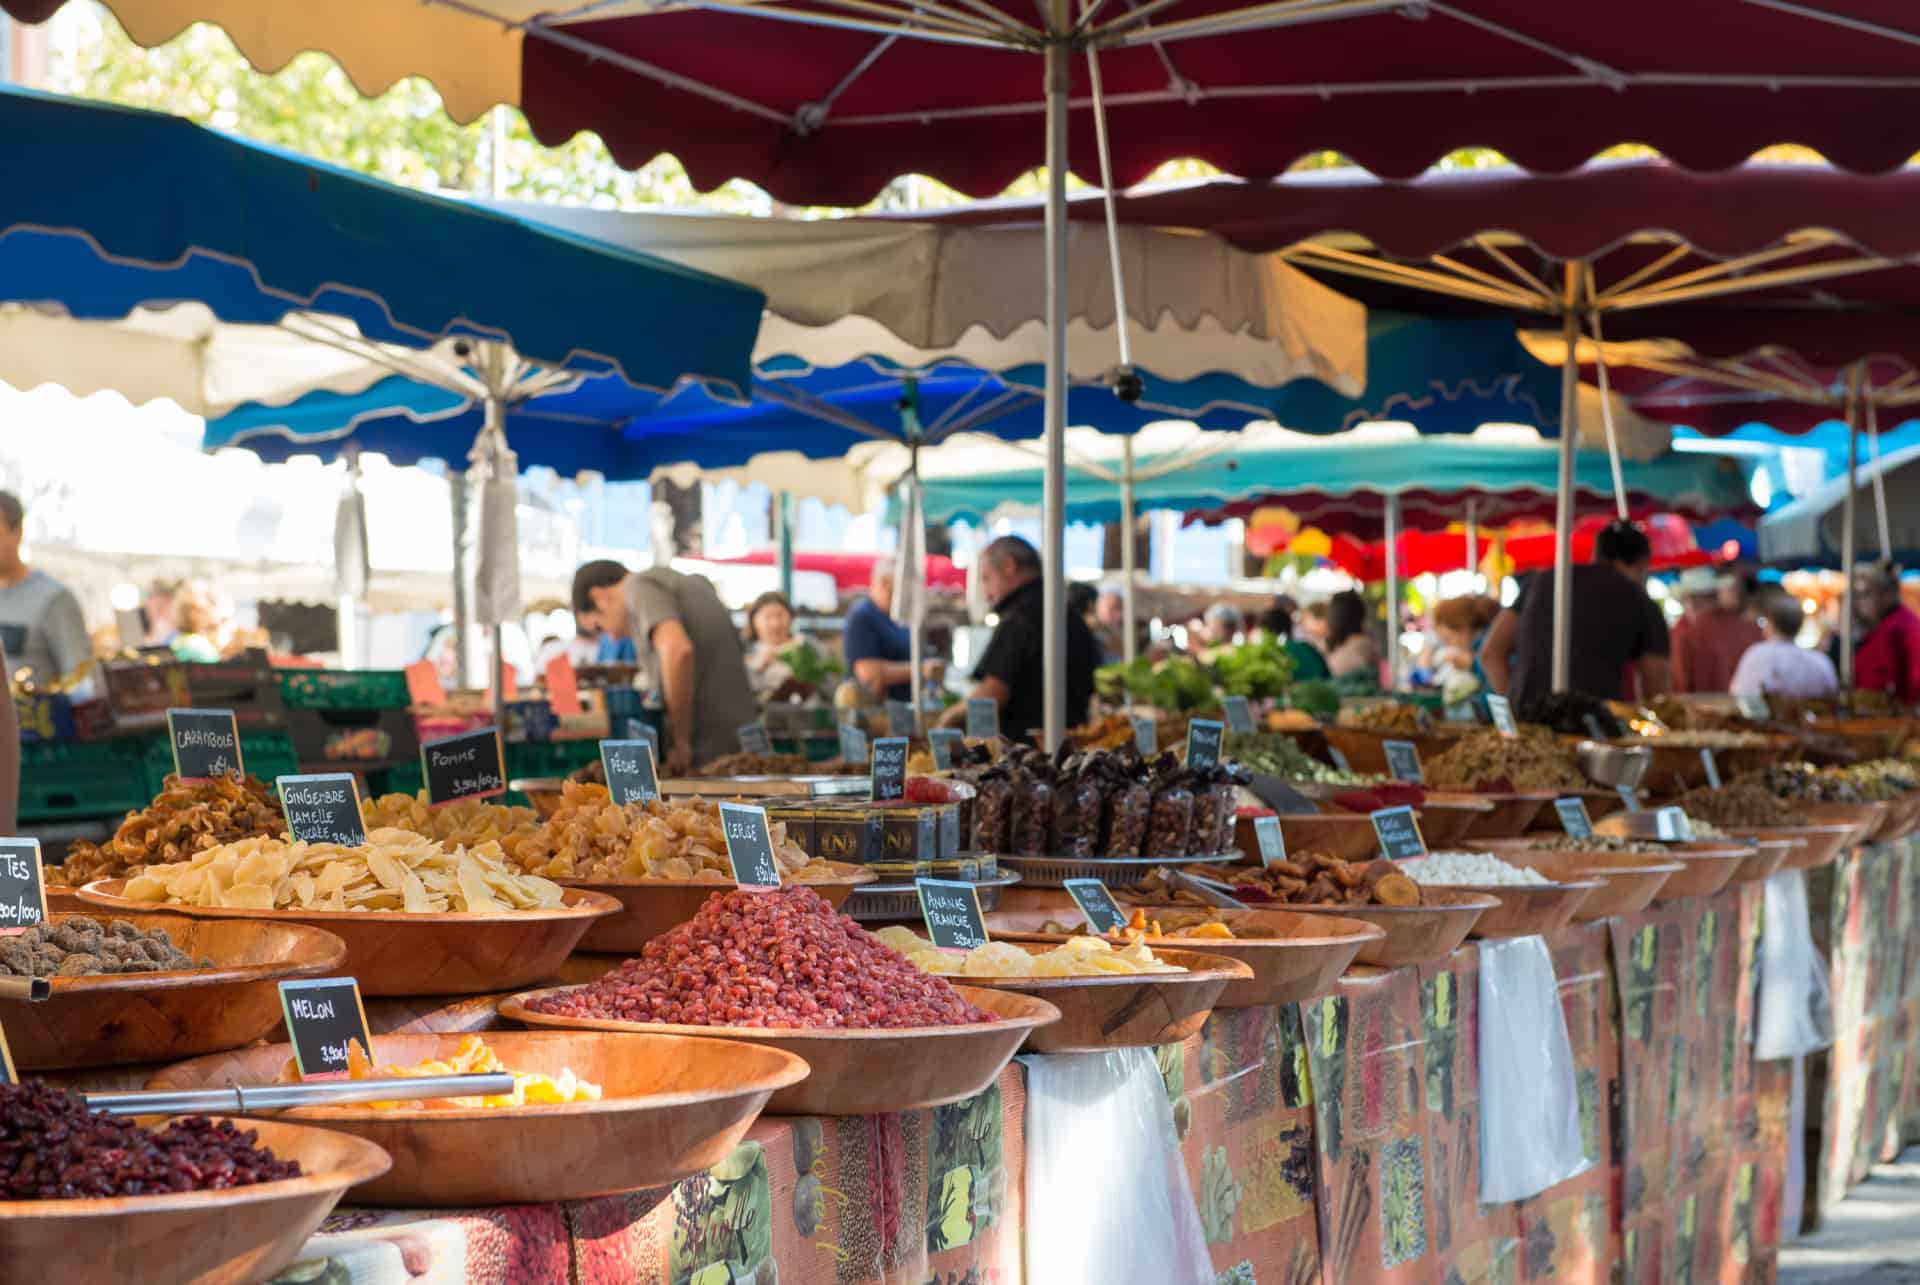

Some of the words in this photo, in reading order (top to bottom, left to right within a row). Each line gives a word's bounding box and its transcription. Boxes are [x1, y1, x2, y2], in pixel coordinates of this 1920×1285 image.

[177, 729, 233, 749] CARAMBOLE
[431, 748, 476, 767] POMME
[290, 808, 335, 825] LAMELLE
[0, 853, 30, 880] TES
[927, 889, 967, 912] ANANAS
[291, 998, 336, 1020] MELON
